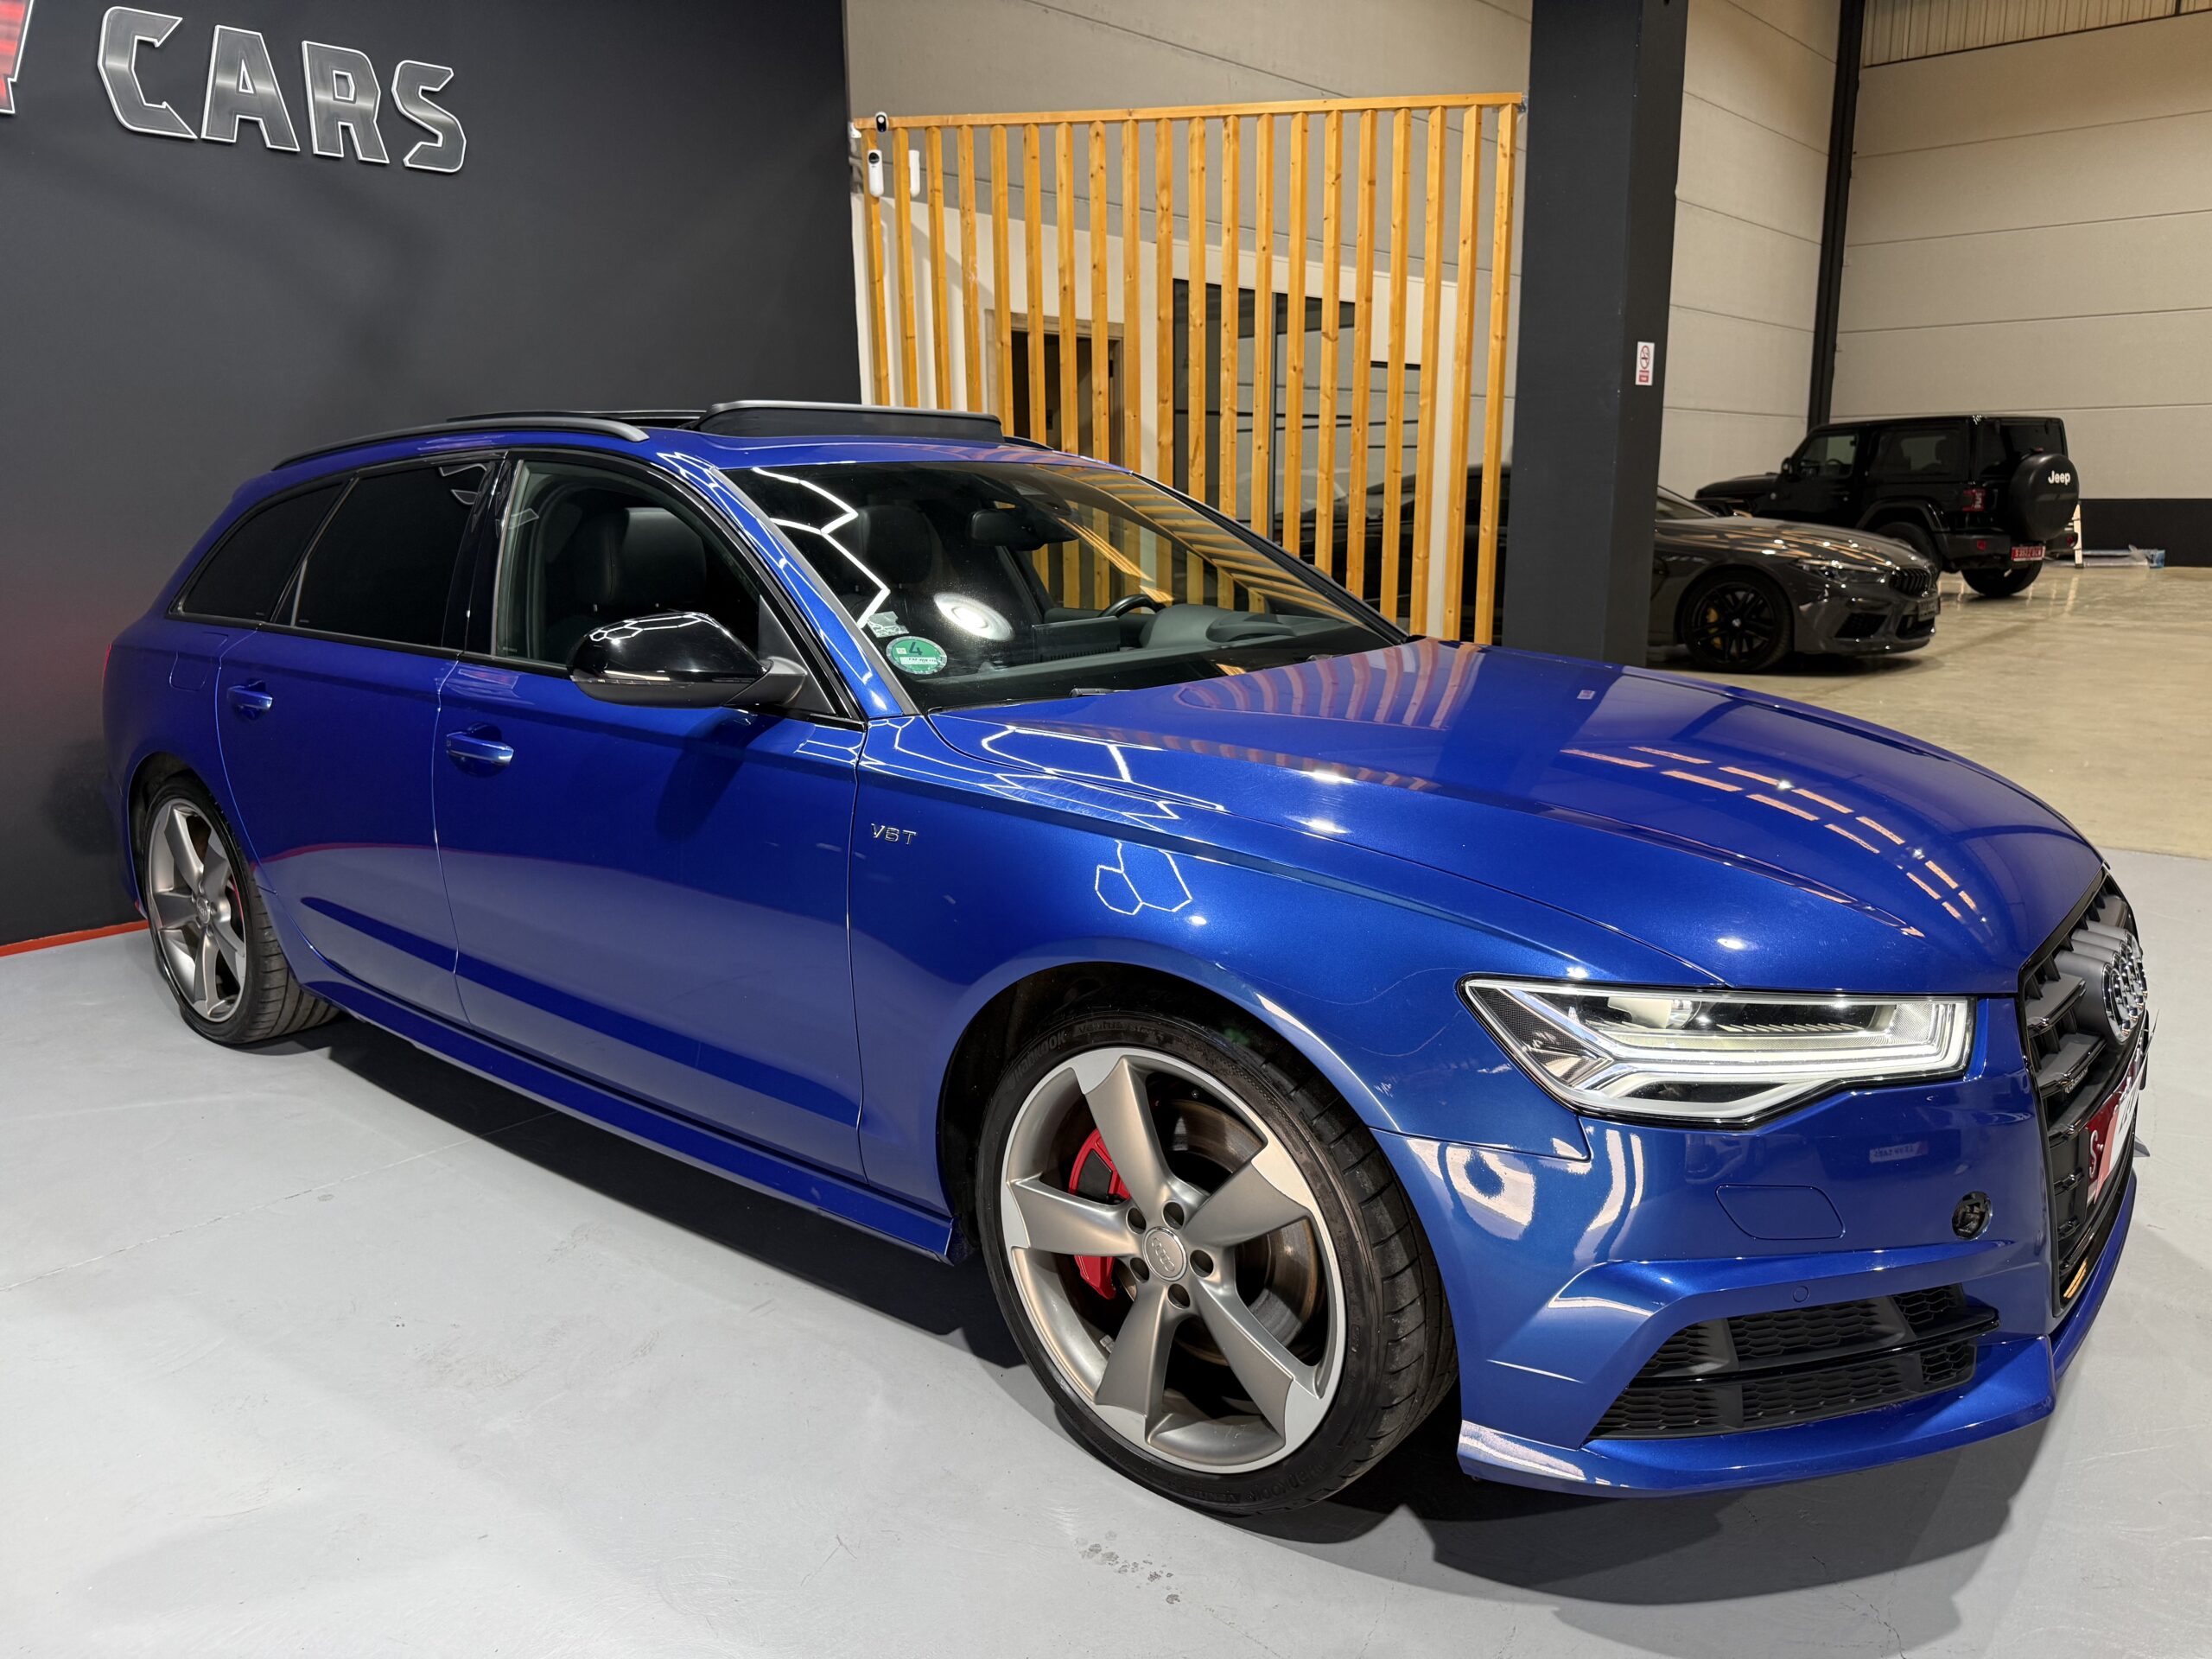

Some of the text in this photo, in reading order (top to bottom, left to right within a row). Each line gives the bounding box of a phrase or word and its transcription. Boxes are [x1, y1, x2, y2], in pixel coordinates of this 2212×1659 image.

[98, 6, 467, 173] CARS
[2048, 470, 2071, 486] Jeep
[908, 641, 924, 656] 4
